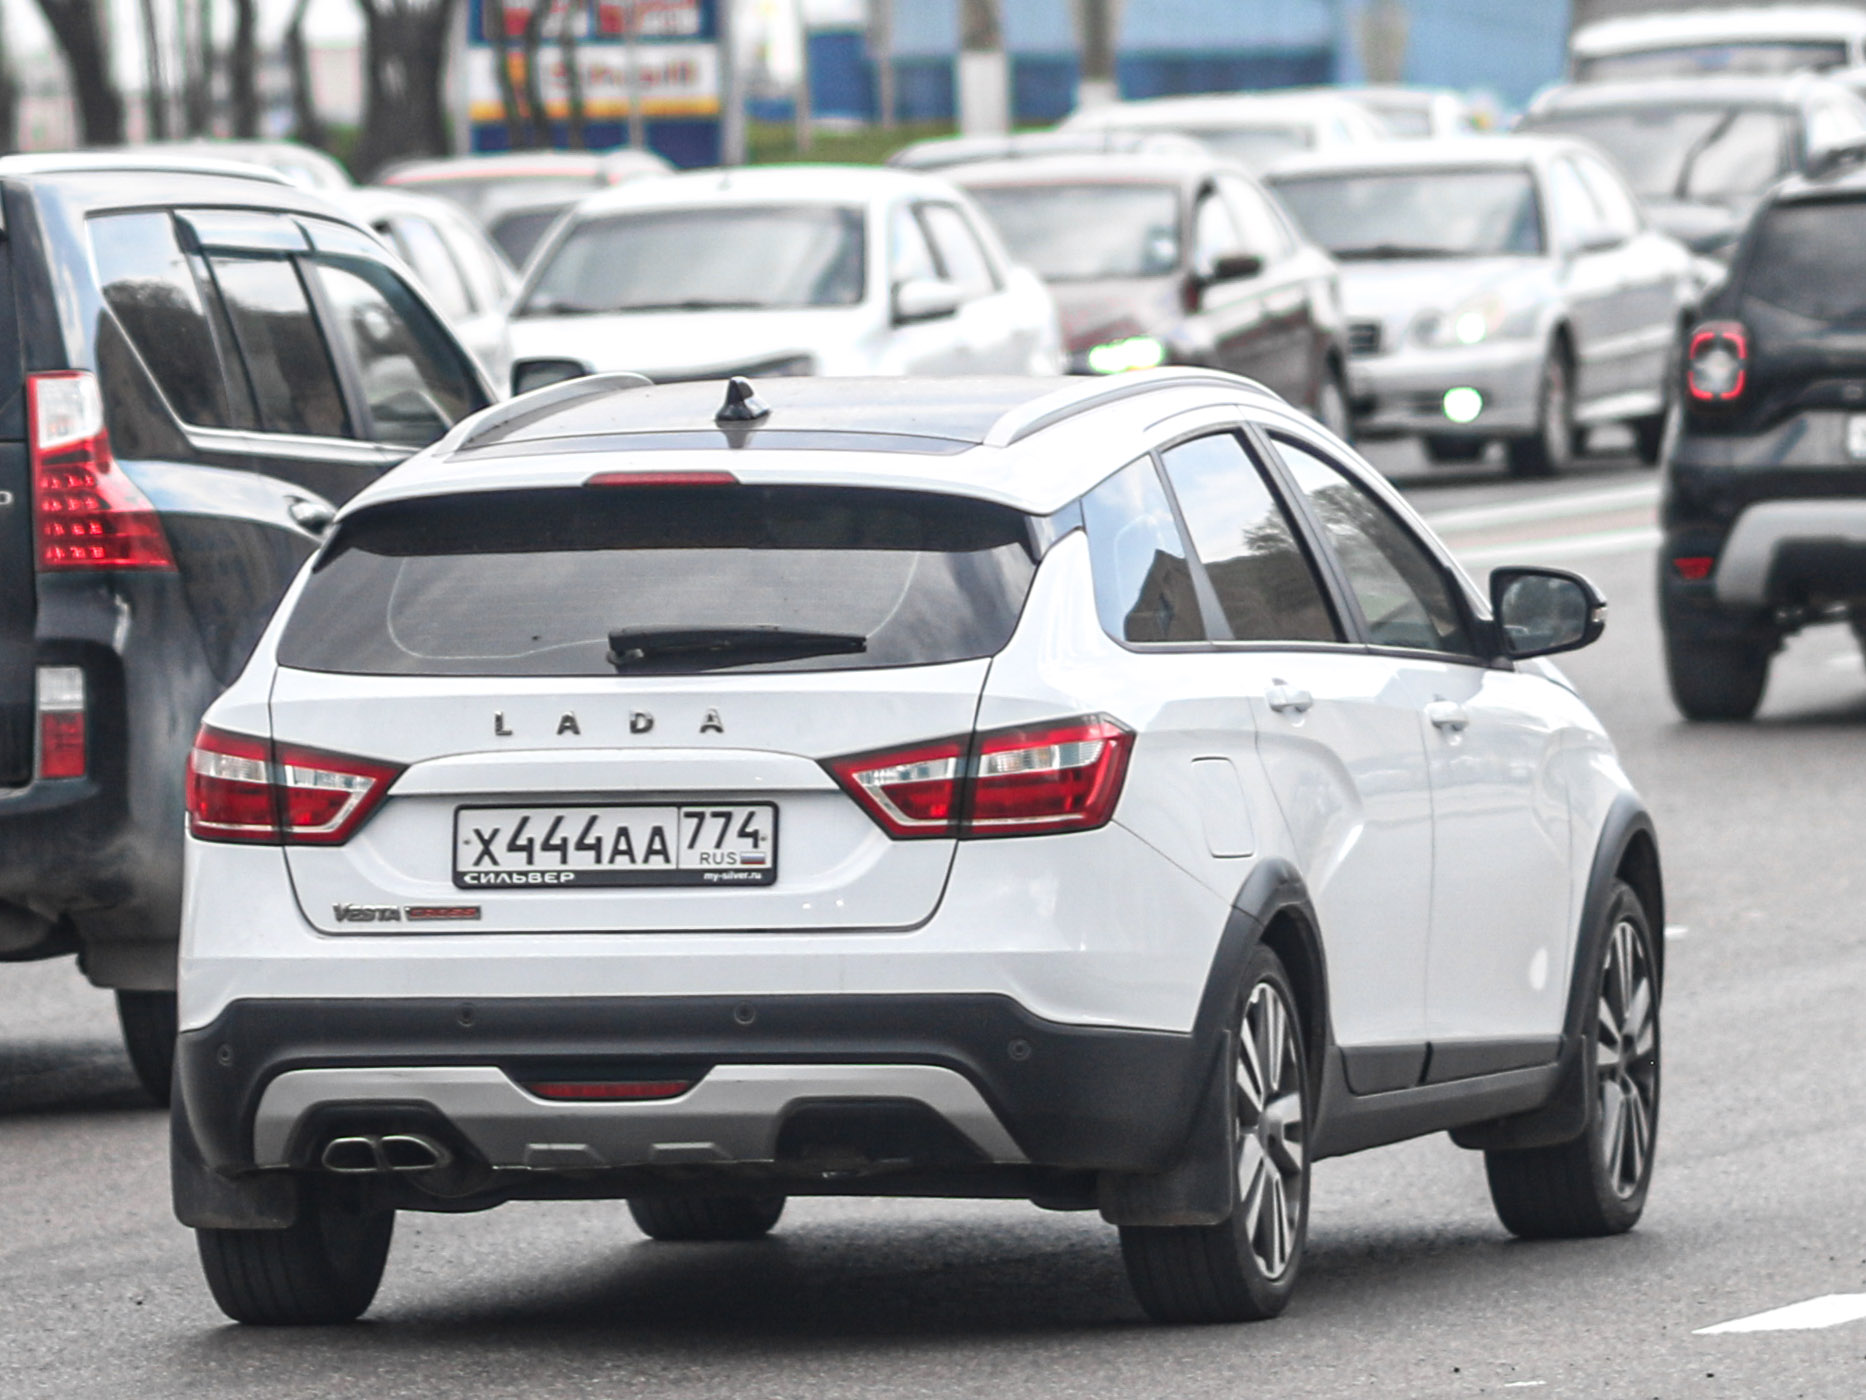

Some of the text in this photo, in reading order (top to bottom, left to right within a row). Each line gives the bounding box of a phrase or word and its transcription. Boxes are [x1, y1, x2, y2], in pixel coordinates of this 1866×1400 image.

[494, 708, 724, 736] LADA
[683, 811, 759, 849] 774
[700, 852, 737, 864] RUS
[463, 872, 576, 884] СИЛЬВЕР
[703, 871, 762, 881] my-silver.ru
